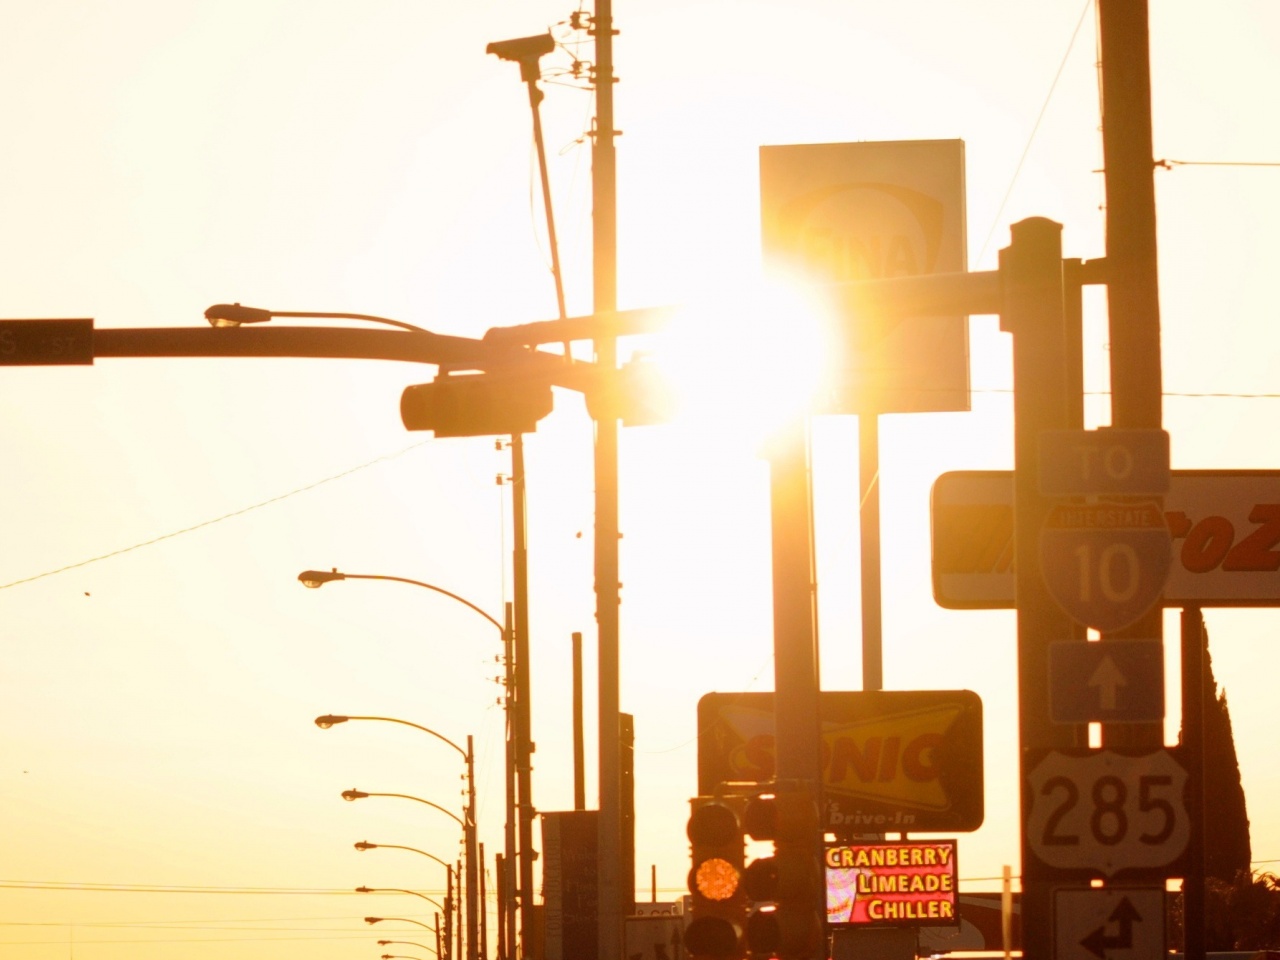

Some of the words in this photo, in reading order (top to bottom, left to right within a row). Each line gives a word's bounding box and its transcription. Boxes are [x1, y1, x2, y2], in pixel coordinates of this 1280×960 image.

[1076, 445, 1134, 480] TO
[1076, 542, 1140, 589] 10
[736, 732, 946, 783] SNIC
[1040, 775, 1176, 846] 285
[825, 847, 952, 868] CRANBERRY
[857, 874, 952, 893] LIMEADE
[869, 900, 953, 919] CHILLER
